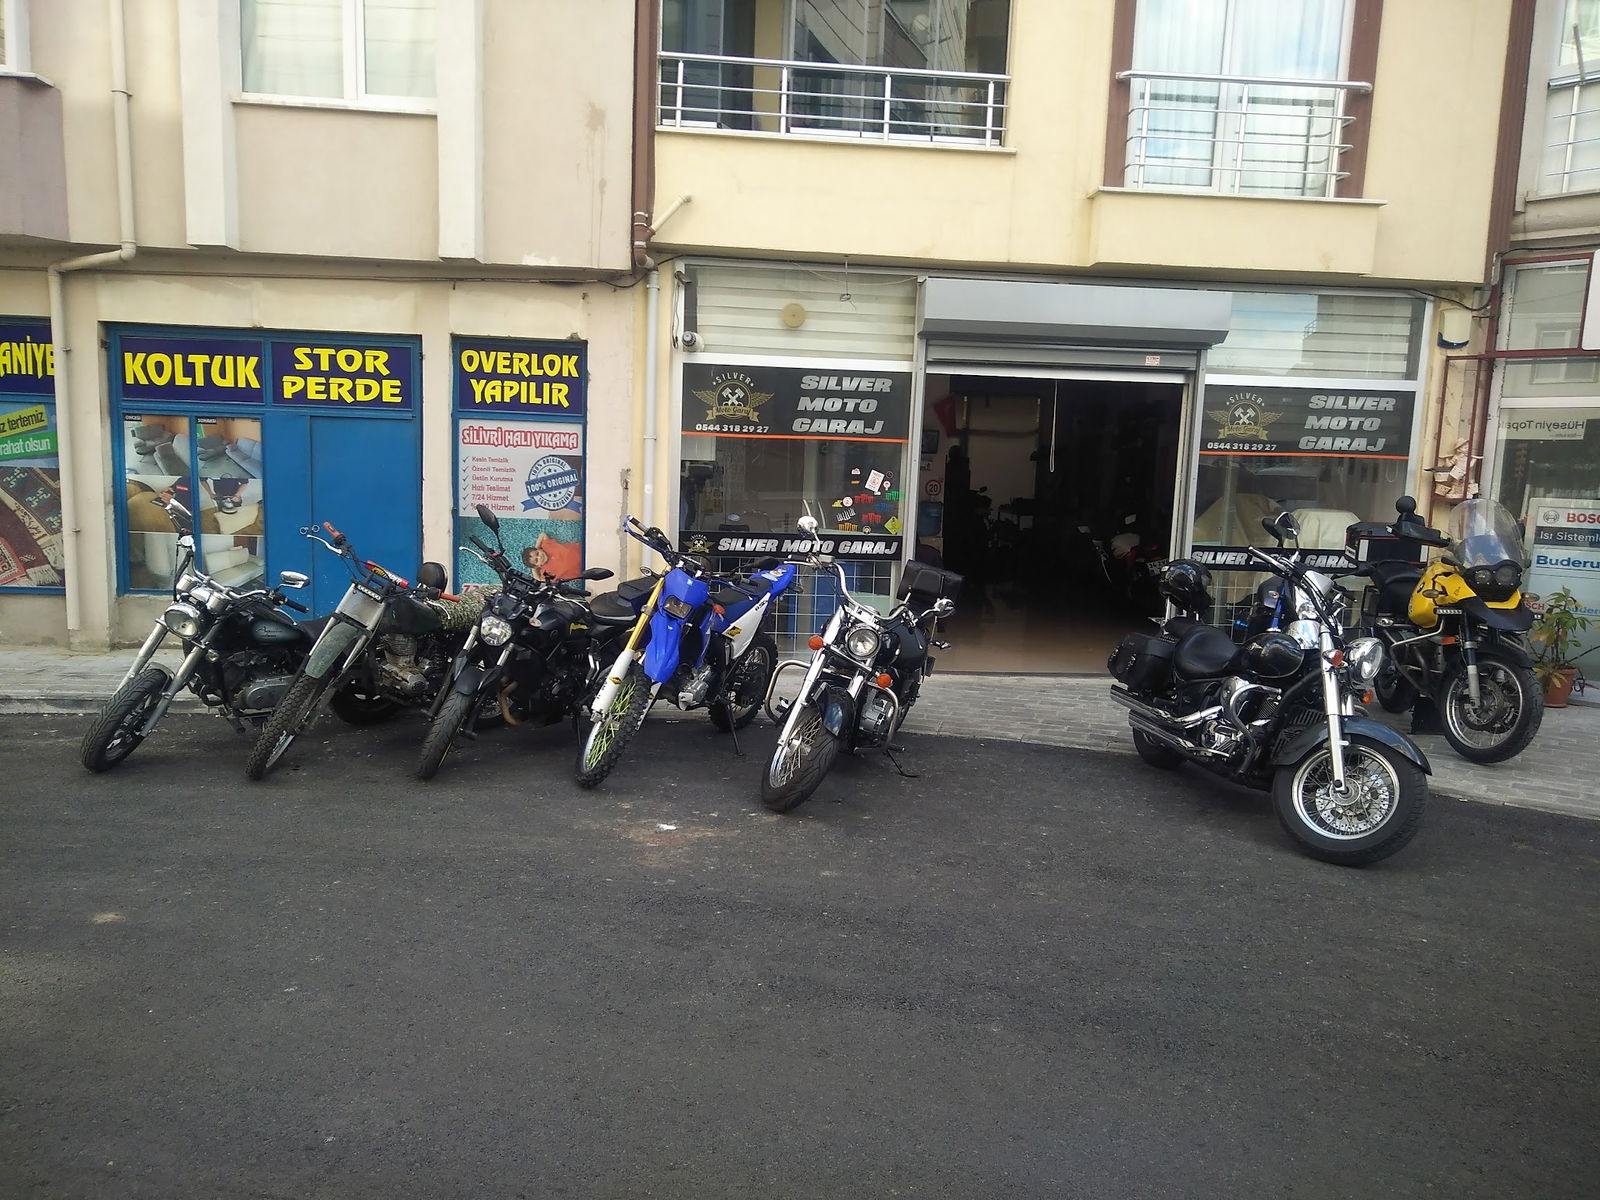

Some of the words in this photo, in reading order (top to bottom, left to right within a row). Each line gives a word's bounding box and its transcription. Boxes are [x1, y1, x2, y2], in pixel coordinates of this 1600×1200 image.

[293, 347, 391, 376] STOR
[461, 349, 579, 378] OVERLOK
[124, 352, 261, 389] KOLTUK
[715, 372, 752, 385] SILVER
[282, 375, 403, 403] PERDE
[800, 375, 892, 392] SILVER
[470, 379, 570, 408] YAPILIR
[1229, 392, 1263, 404] SILVER
[797, 396, 878, 413] MOTO
[1308, 395, 1396, 411] SILVER
[7, 410, 45, 430] tertemiz
[695, 423, 721, 431] 0544
[721, 424, 741, 432] 318
[742, 425, 755, 433] 29
[792, 417, 884, 435] GARAJ
[1304, 415, 1382, 431] MOTO
[0, 439, 24, 455] rahat
[25, 437, 51, 453] olsun
[462, 426, 503, 447] SİLİVRİ
[503, 430, 532, 448] HALI
[532, 431, 579, 450] YIKAMA
[1231, 442, 1250, 450] 318
[1251, 443, 1263, 451] 29
[1298, 436, 1386, 452] GARAJ
[527, 481, 547, 494] 100%
[547, 473, 578, 488] ORIGINAL
[928, 484, 939, 493] 20
[491, 503, 516, 511] Hizmet
[717, 537, 778, 552] SILVER
[781, 539, 835, 553] MOTO
[838, 541, 899, 554] GARAJ
[1191, 551, 1248, 566] SILVER
[1536, 555, 1600, 569] Buderu
